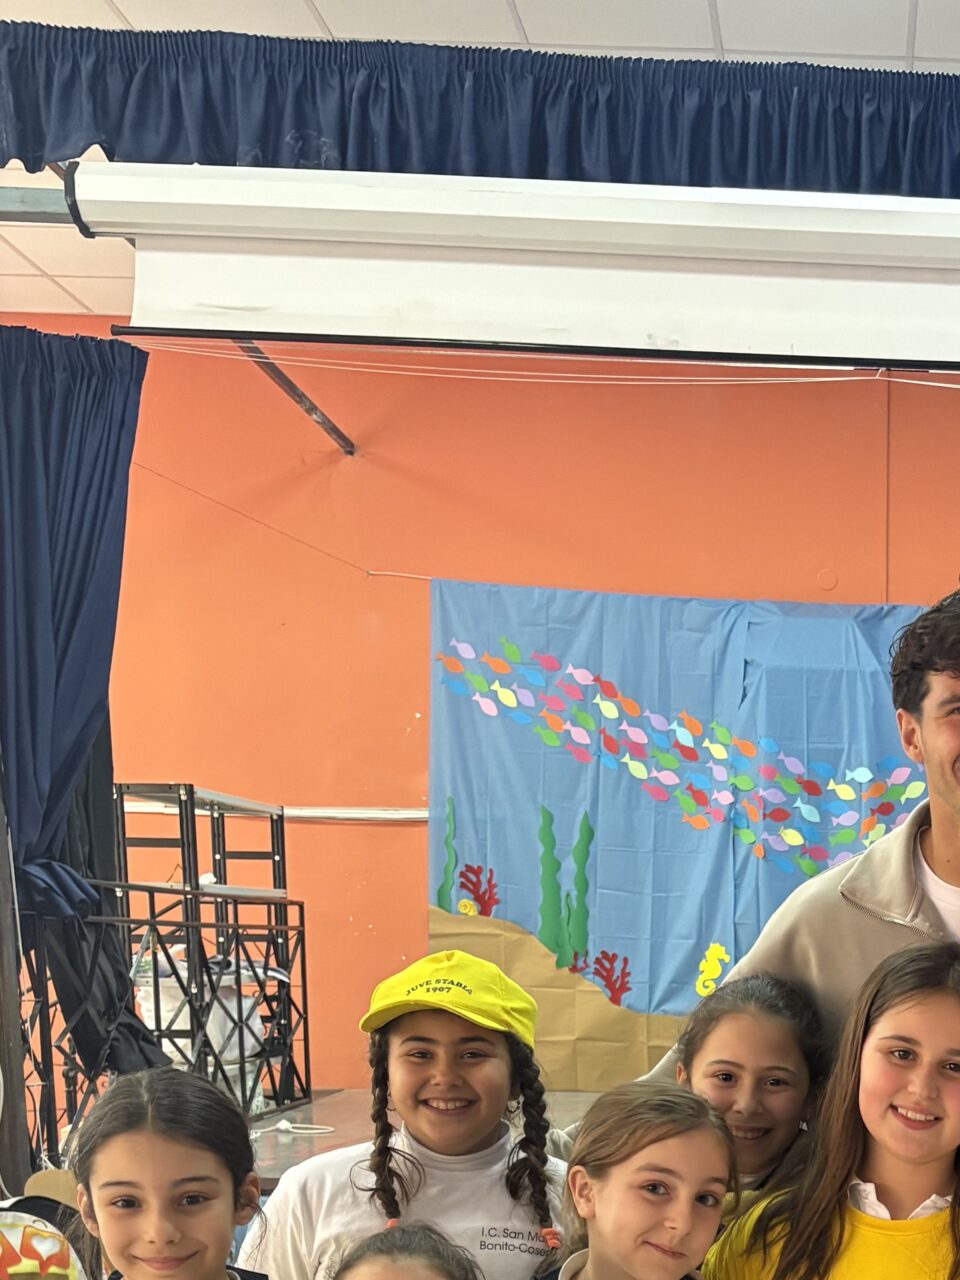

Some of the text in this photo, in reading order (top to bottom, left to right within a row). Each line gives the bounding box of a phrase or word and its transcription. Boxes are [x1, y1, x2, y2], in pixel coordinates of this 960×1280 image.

[405, 980, 432, 996] JUVE
[481, 1227, 500, 1238] I.C.
[502, 1228, 524, 1240] San
